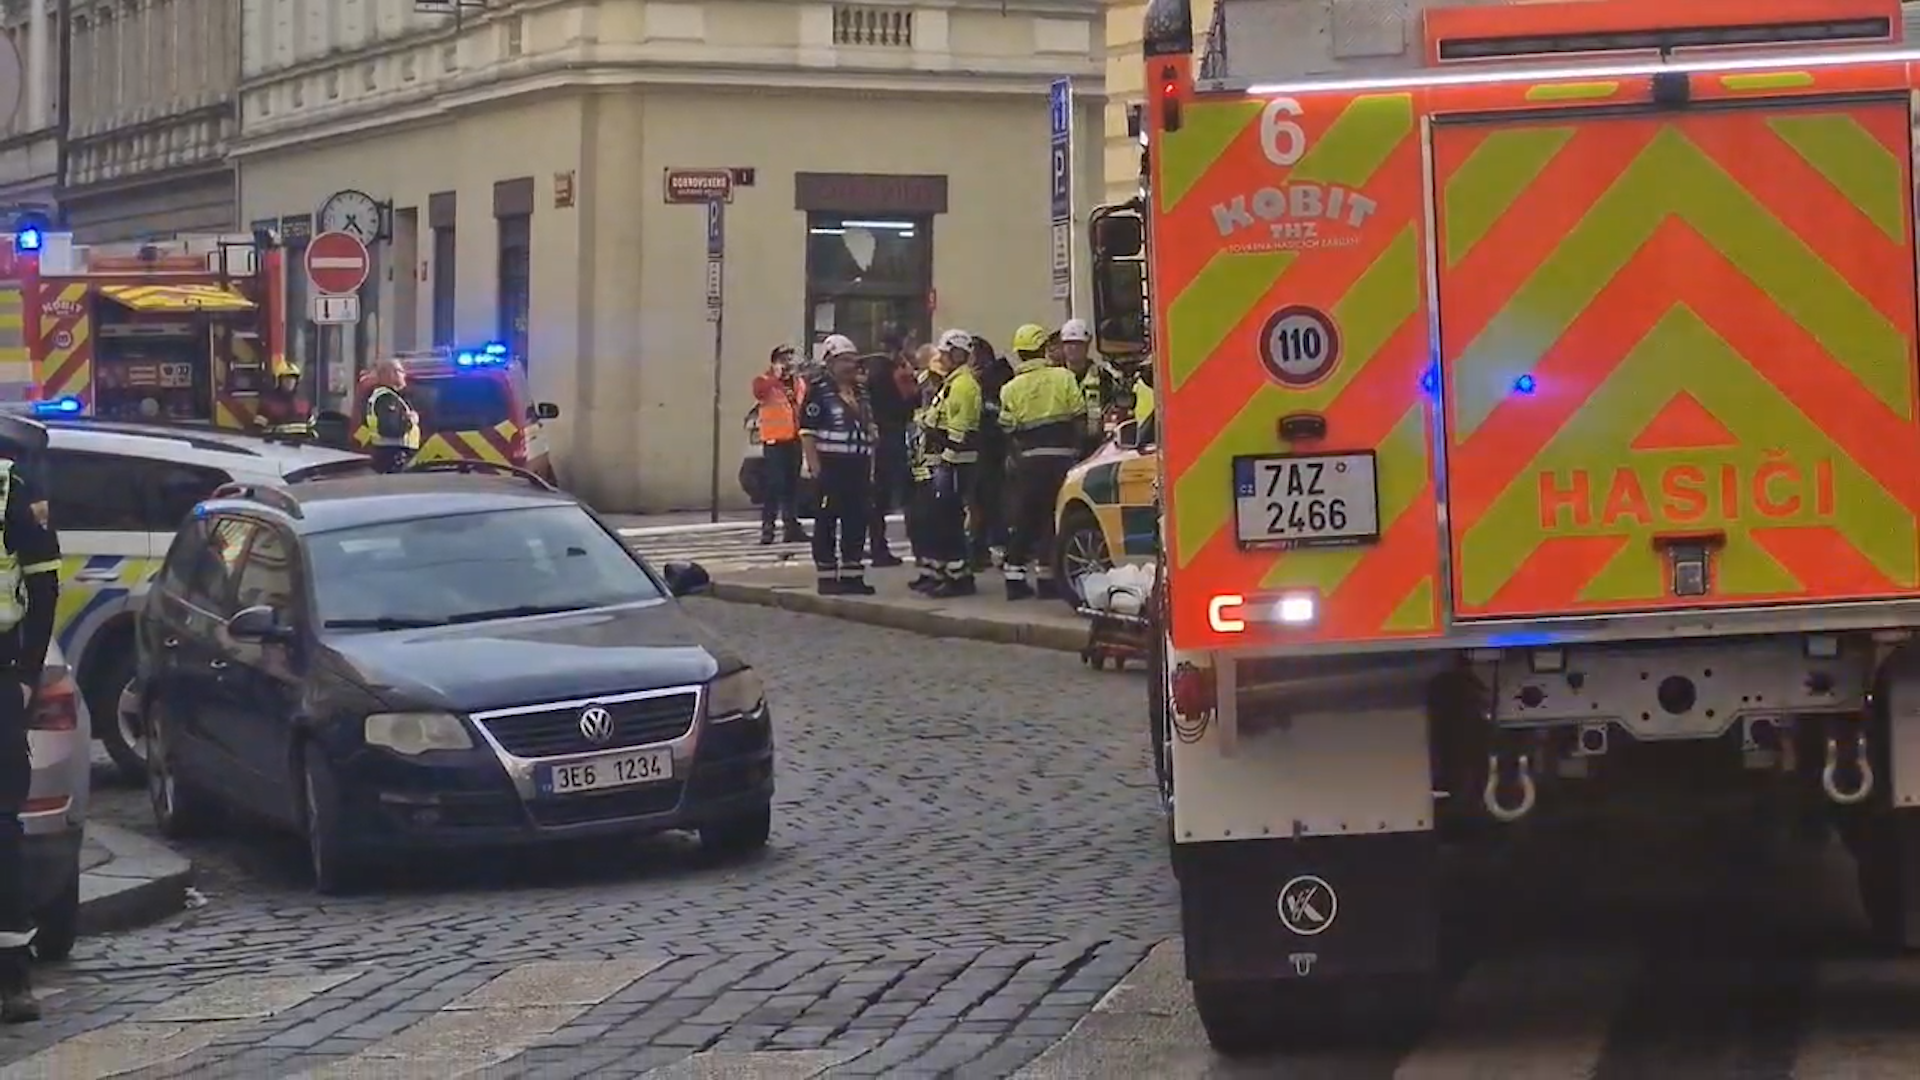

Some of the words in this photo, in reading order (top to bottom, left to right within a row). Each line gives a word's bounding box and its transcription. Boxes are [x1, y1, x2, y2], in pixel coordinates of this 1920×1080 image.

[1260, 97, 1305, 166] 6
[1211, 185, 1377, 236] KOBIT
[1270, 222, 1317, 238] THZ
[1278, 328, 1321, 363] 110
[1265, 463, 1325, 497] 7AZ
[1539, 448, 1835, 529] HASIČI
[1266, 499, 1347, 534] 2466
[558, 765, 596, 788] 3E6
[614, 754, 661, 782] 1234
